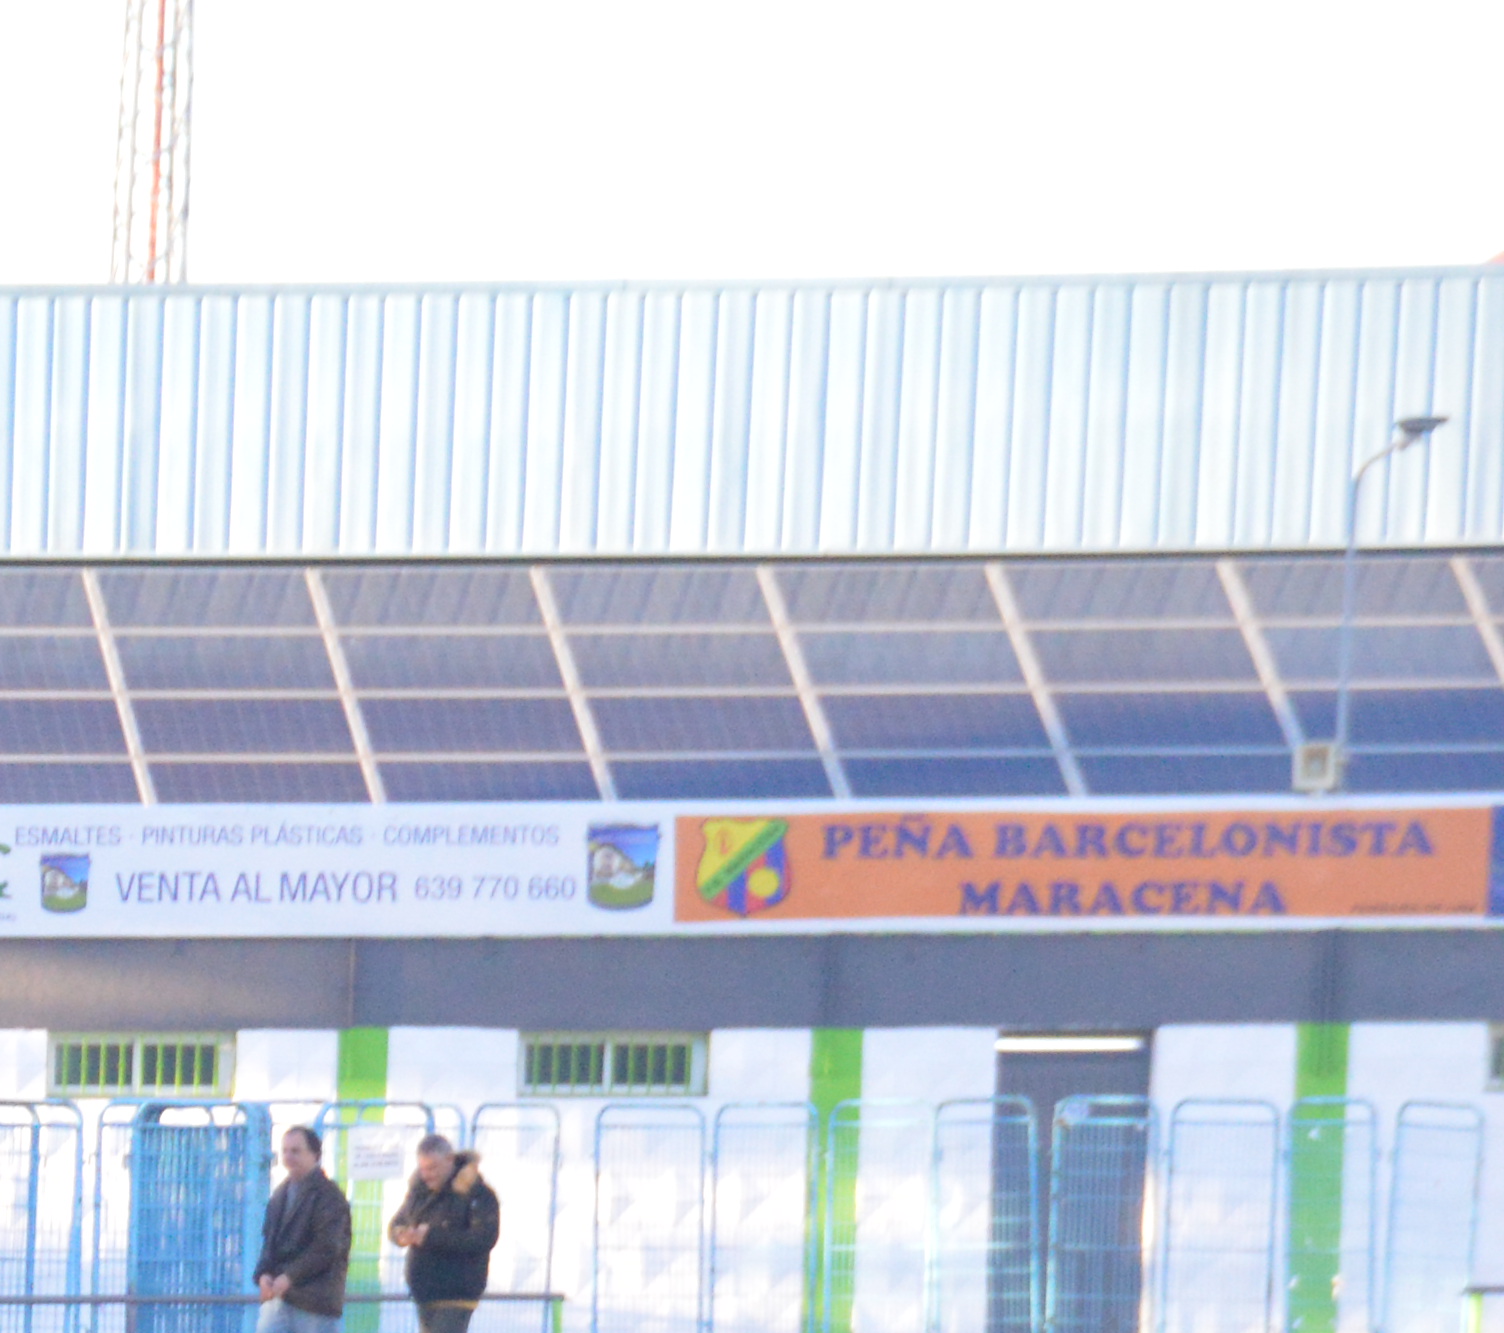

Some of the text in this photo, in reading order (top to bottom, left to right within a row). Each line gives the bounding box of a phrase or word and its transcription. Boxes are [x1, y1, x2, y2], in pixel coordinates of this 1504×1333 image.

[14, 819, 561, 847] ESMALTES PINTURAS PLÁSTICAS COMPLEMENTOS
[821, 814, 1434, 859] PEÑA BARCELONISTA
[115, 870, 576, 903] VENTA AL MAYOR 639 770 660
[957, 880, 1288, 916] MARACENA
